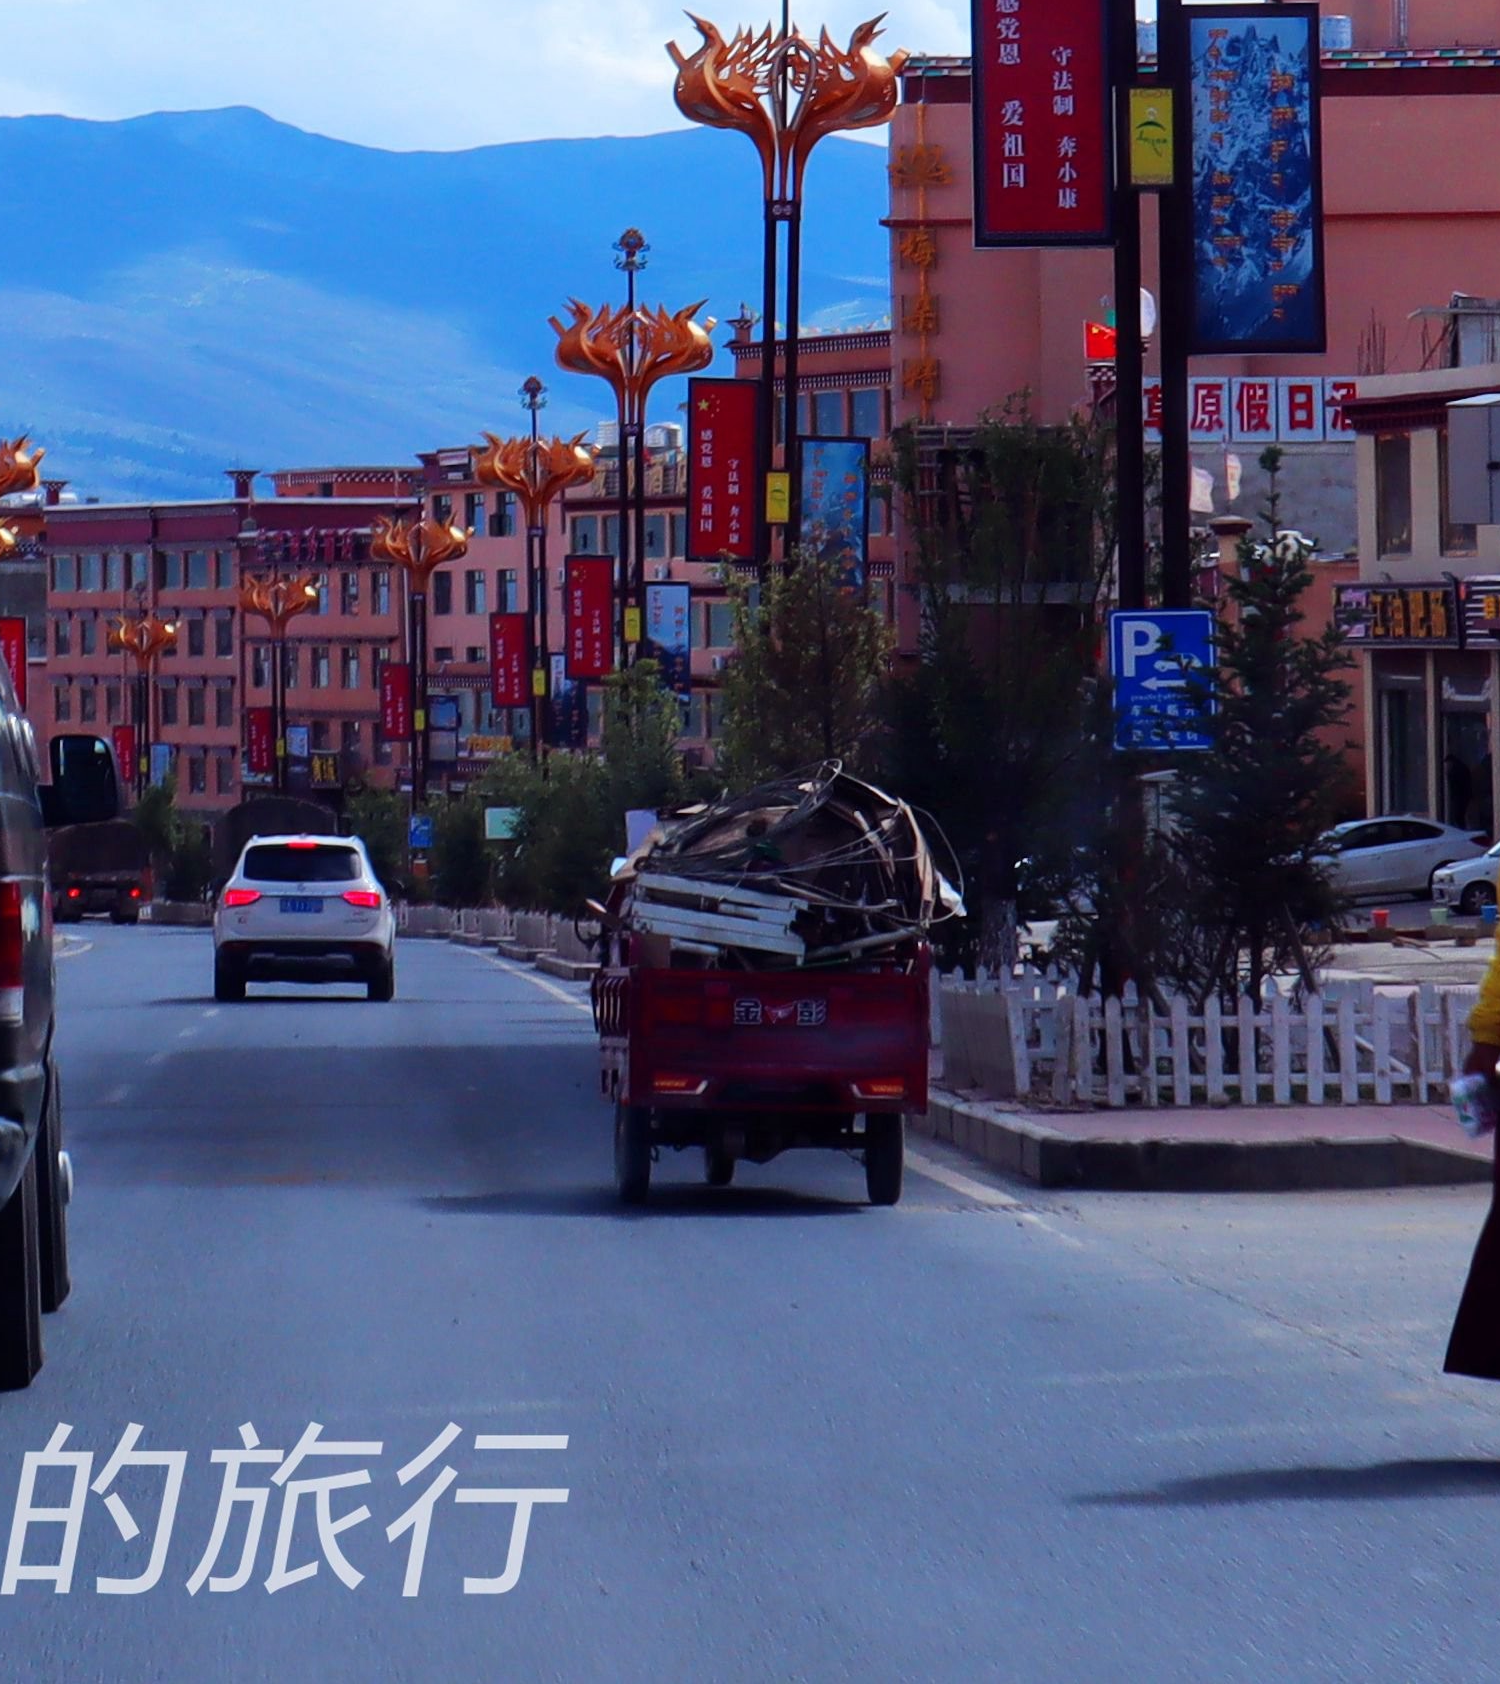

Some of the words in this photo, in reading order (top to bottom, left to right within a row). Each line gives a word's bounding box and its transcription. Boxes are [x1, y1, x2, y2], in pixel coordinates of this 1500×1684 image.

[1052, 45, 1074, 117] 守法制
[1000, 99, 1025, 189] 爱祖国
[1057, 135, 1078, 210] 奔小康
[1122, 620, 1162, 677] P
[733, 998, 827, 1026] 金彭
